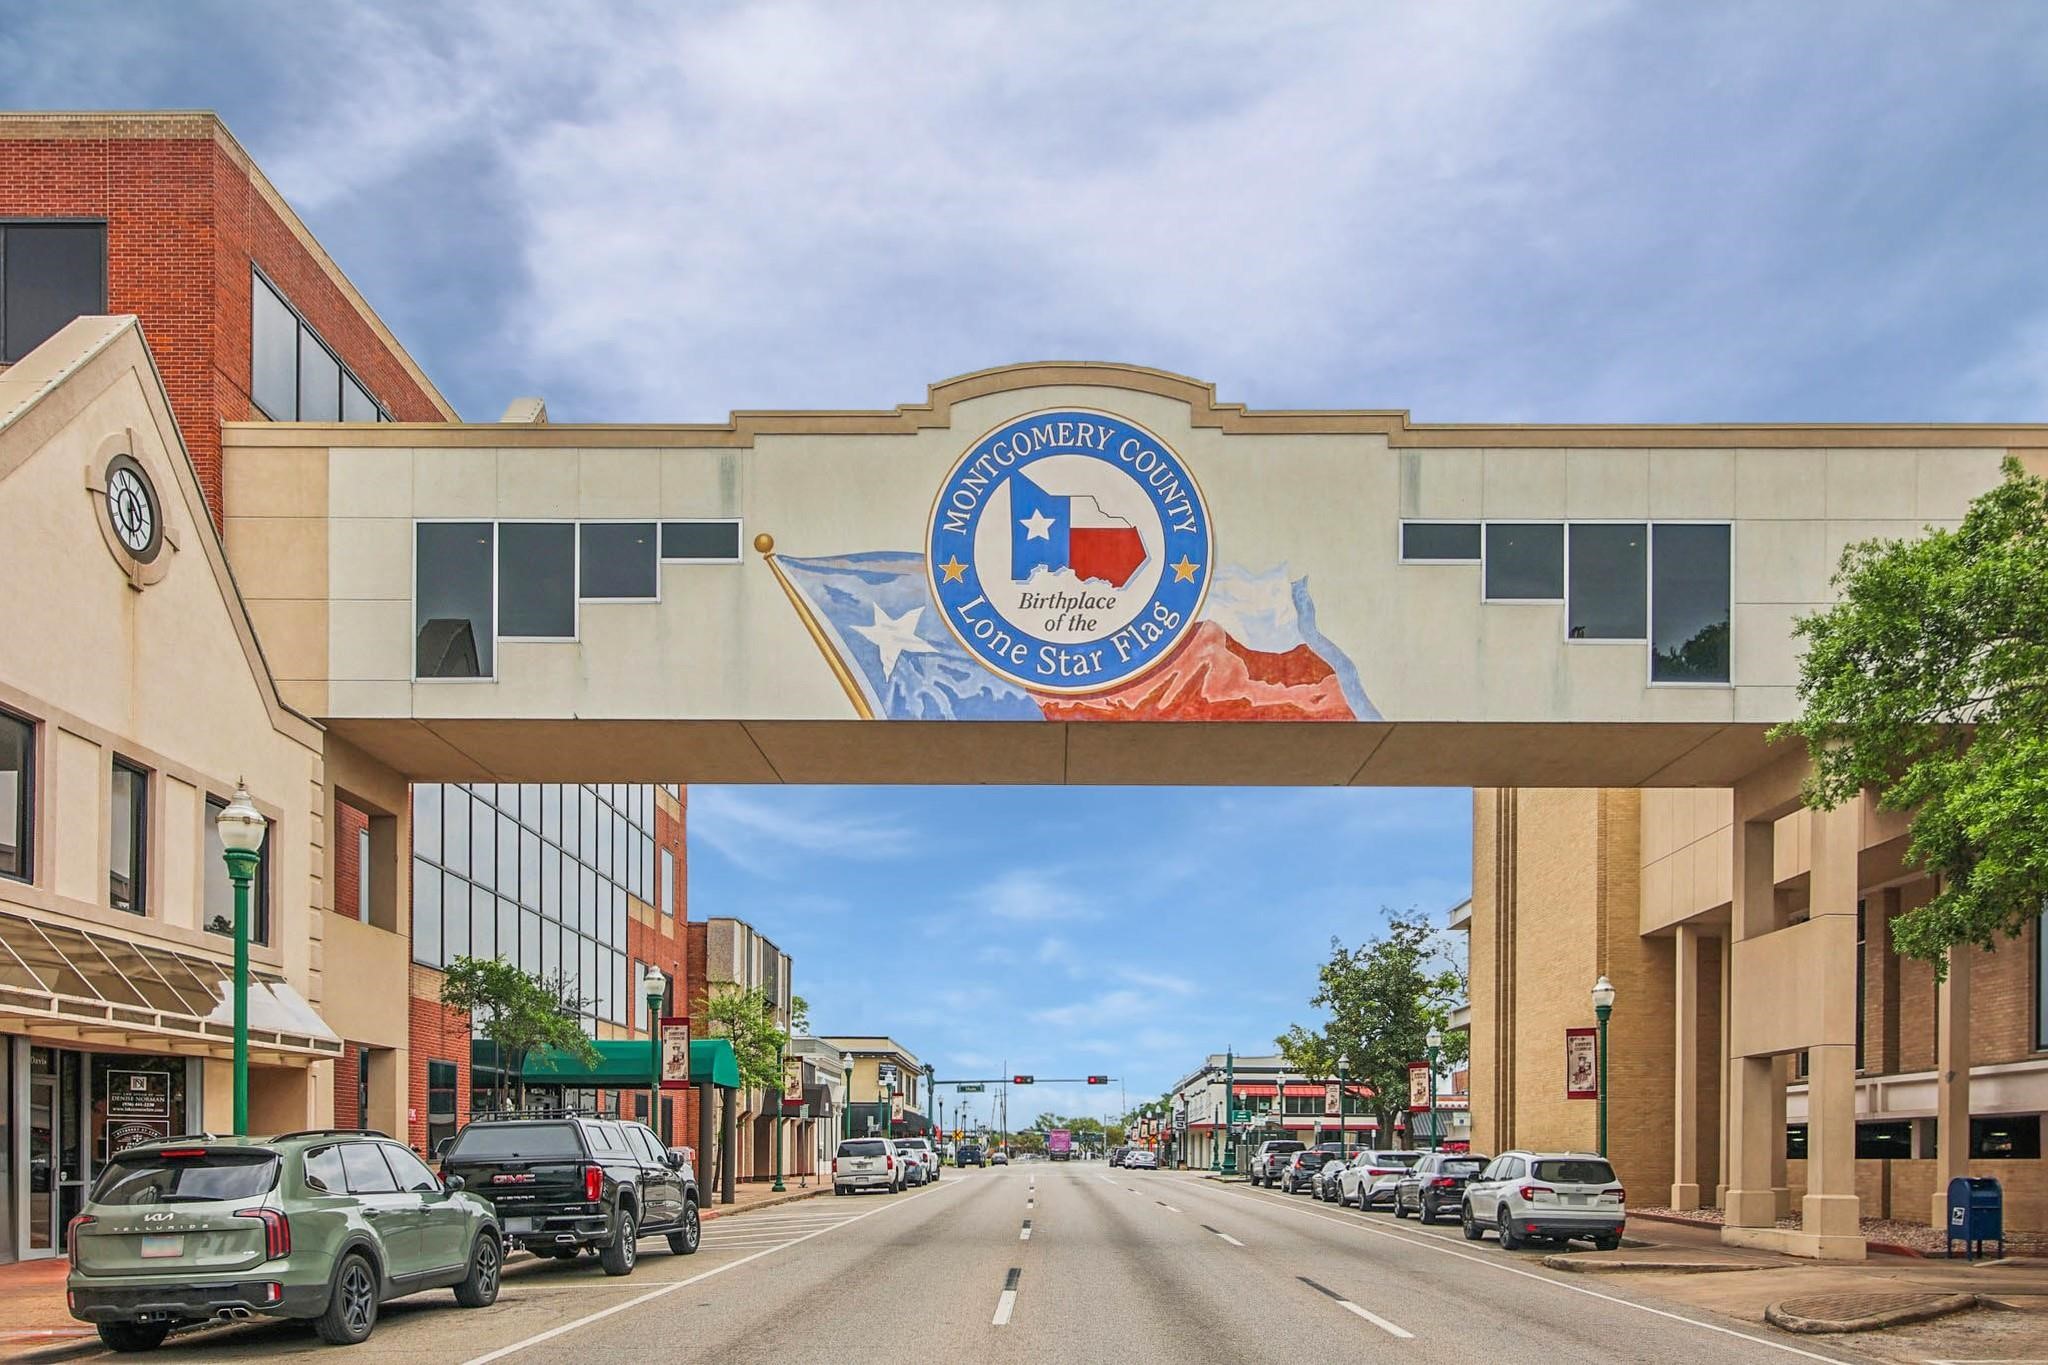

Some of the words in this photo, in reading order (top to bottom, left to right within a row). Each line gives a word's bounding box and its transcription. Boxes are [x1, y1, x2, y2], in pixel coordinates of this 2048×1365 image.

[943, 422, 1115, 535] MONTGOMERY
[1120, 439, 1197, 533] COUNTY
[1018, 592, 1116, 613] Birthplace
[1045, 613, 1066, 631] of
[1068, 614, 1097, 631] the
[957, 595, 1028, 664] Lone
[1037, 645, 1102, 676] Star
[1110, 601, 1180, 663] Flag
[493, 1174, 535, 1184] GMC
[144, 1212, 174, 1222] KIA
[113, 1224, 209, 1232] TELLURIDE
